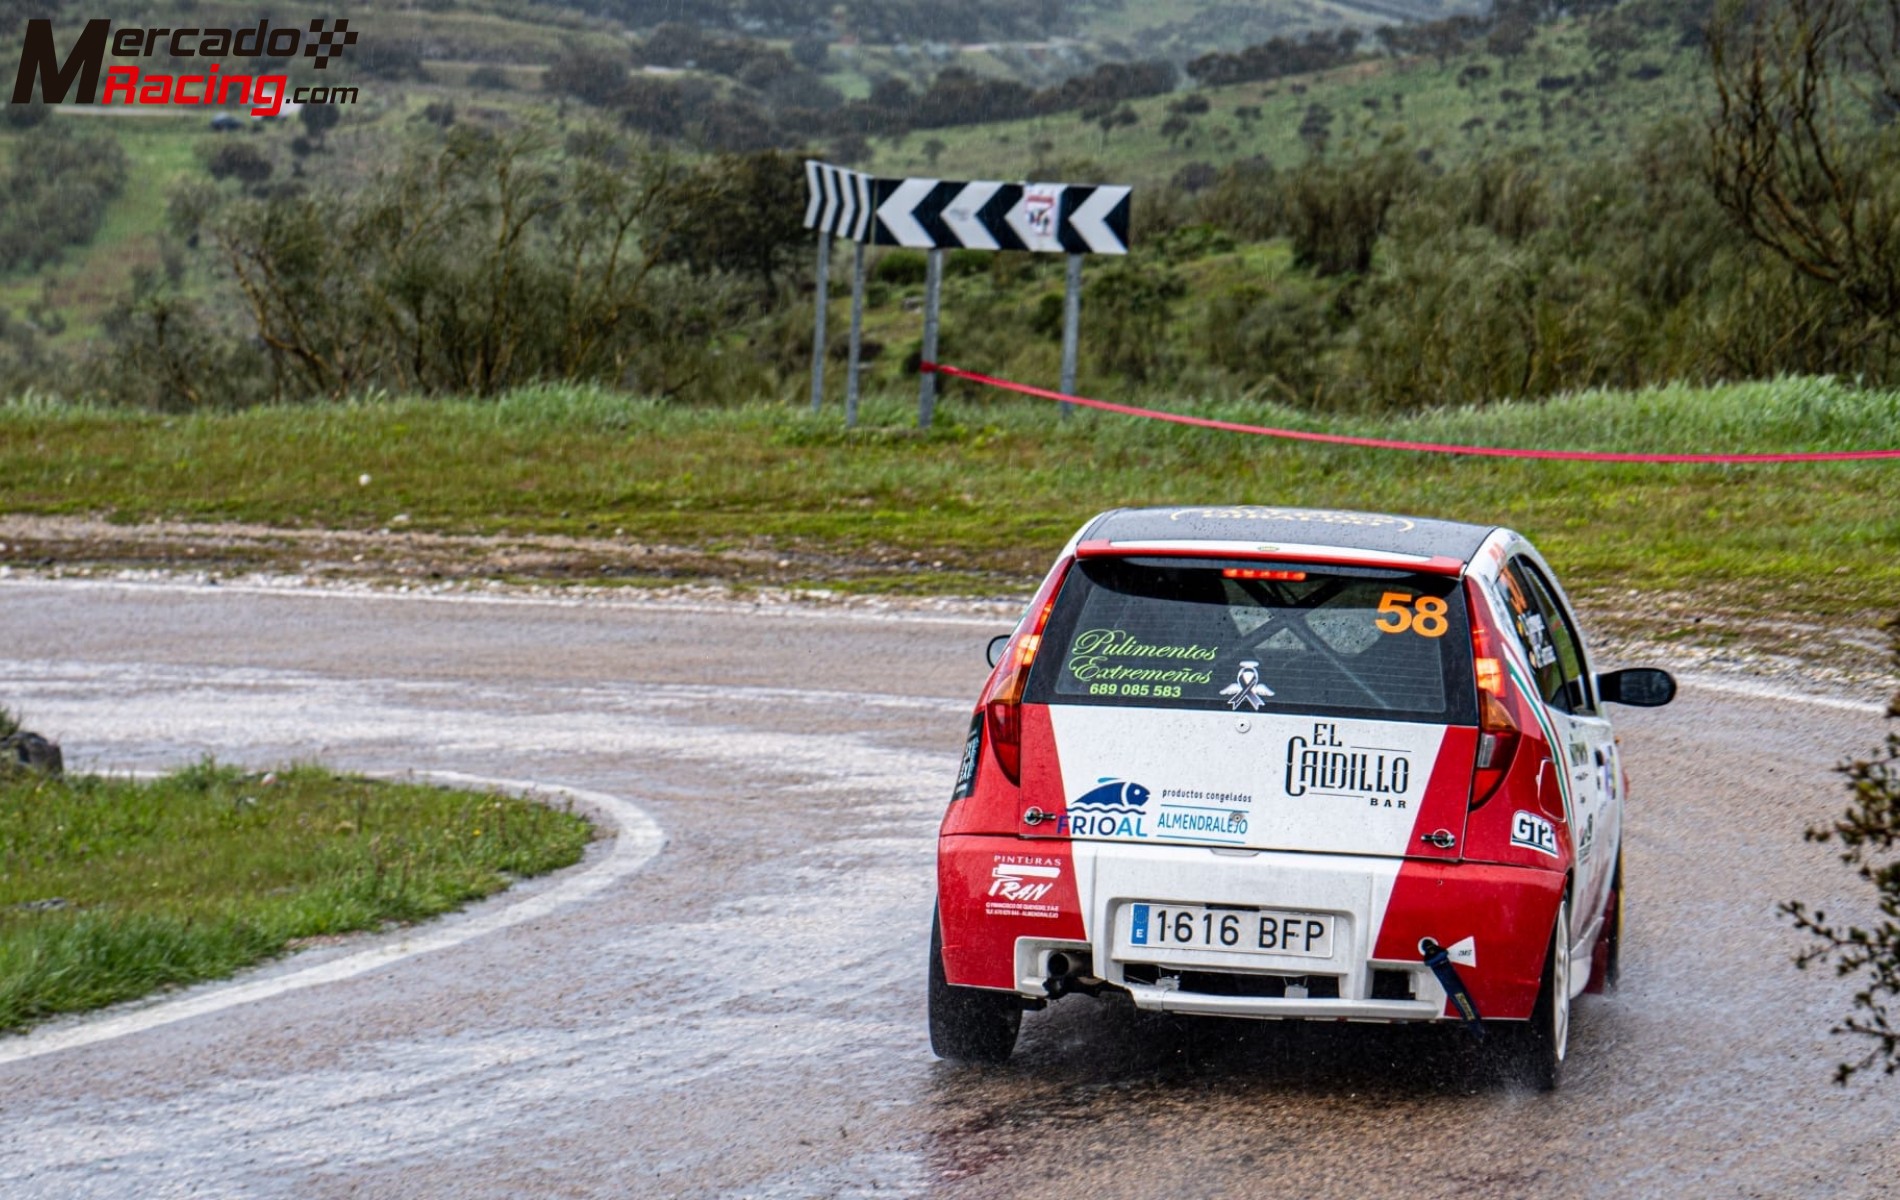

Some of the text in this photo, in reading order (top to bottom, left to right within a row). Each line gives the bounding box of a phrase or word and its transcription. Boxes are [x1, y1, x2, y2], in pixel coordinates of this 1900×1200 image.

[1375, 592, 1448, 637] 58
[1072, 629, 1218, 661] Pulimentos
[1068, 656, 1213, 684] Extremeños
[1090, 683, 1181, 698] 689 085 583
[1313, 723, 1343, 747] EL
[1285, 736, 1409, 797] CALDILLO
[1162, 788, 1252, 803] productos congelados
[1370, 798, 1406, 808] BAR
[1057, 815, 1148, 837] FRIOAL
[1157, 812, 1248, 835] ALMENDRALEJO
[994, 855, 1061, 866] PINTURAS
[988, 877, 1054, 901] TRAN
[1136, 929, 1143, 938] E
[1157, 910, 1324, 951] 1616 BFP
